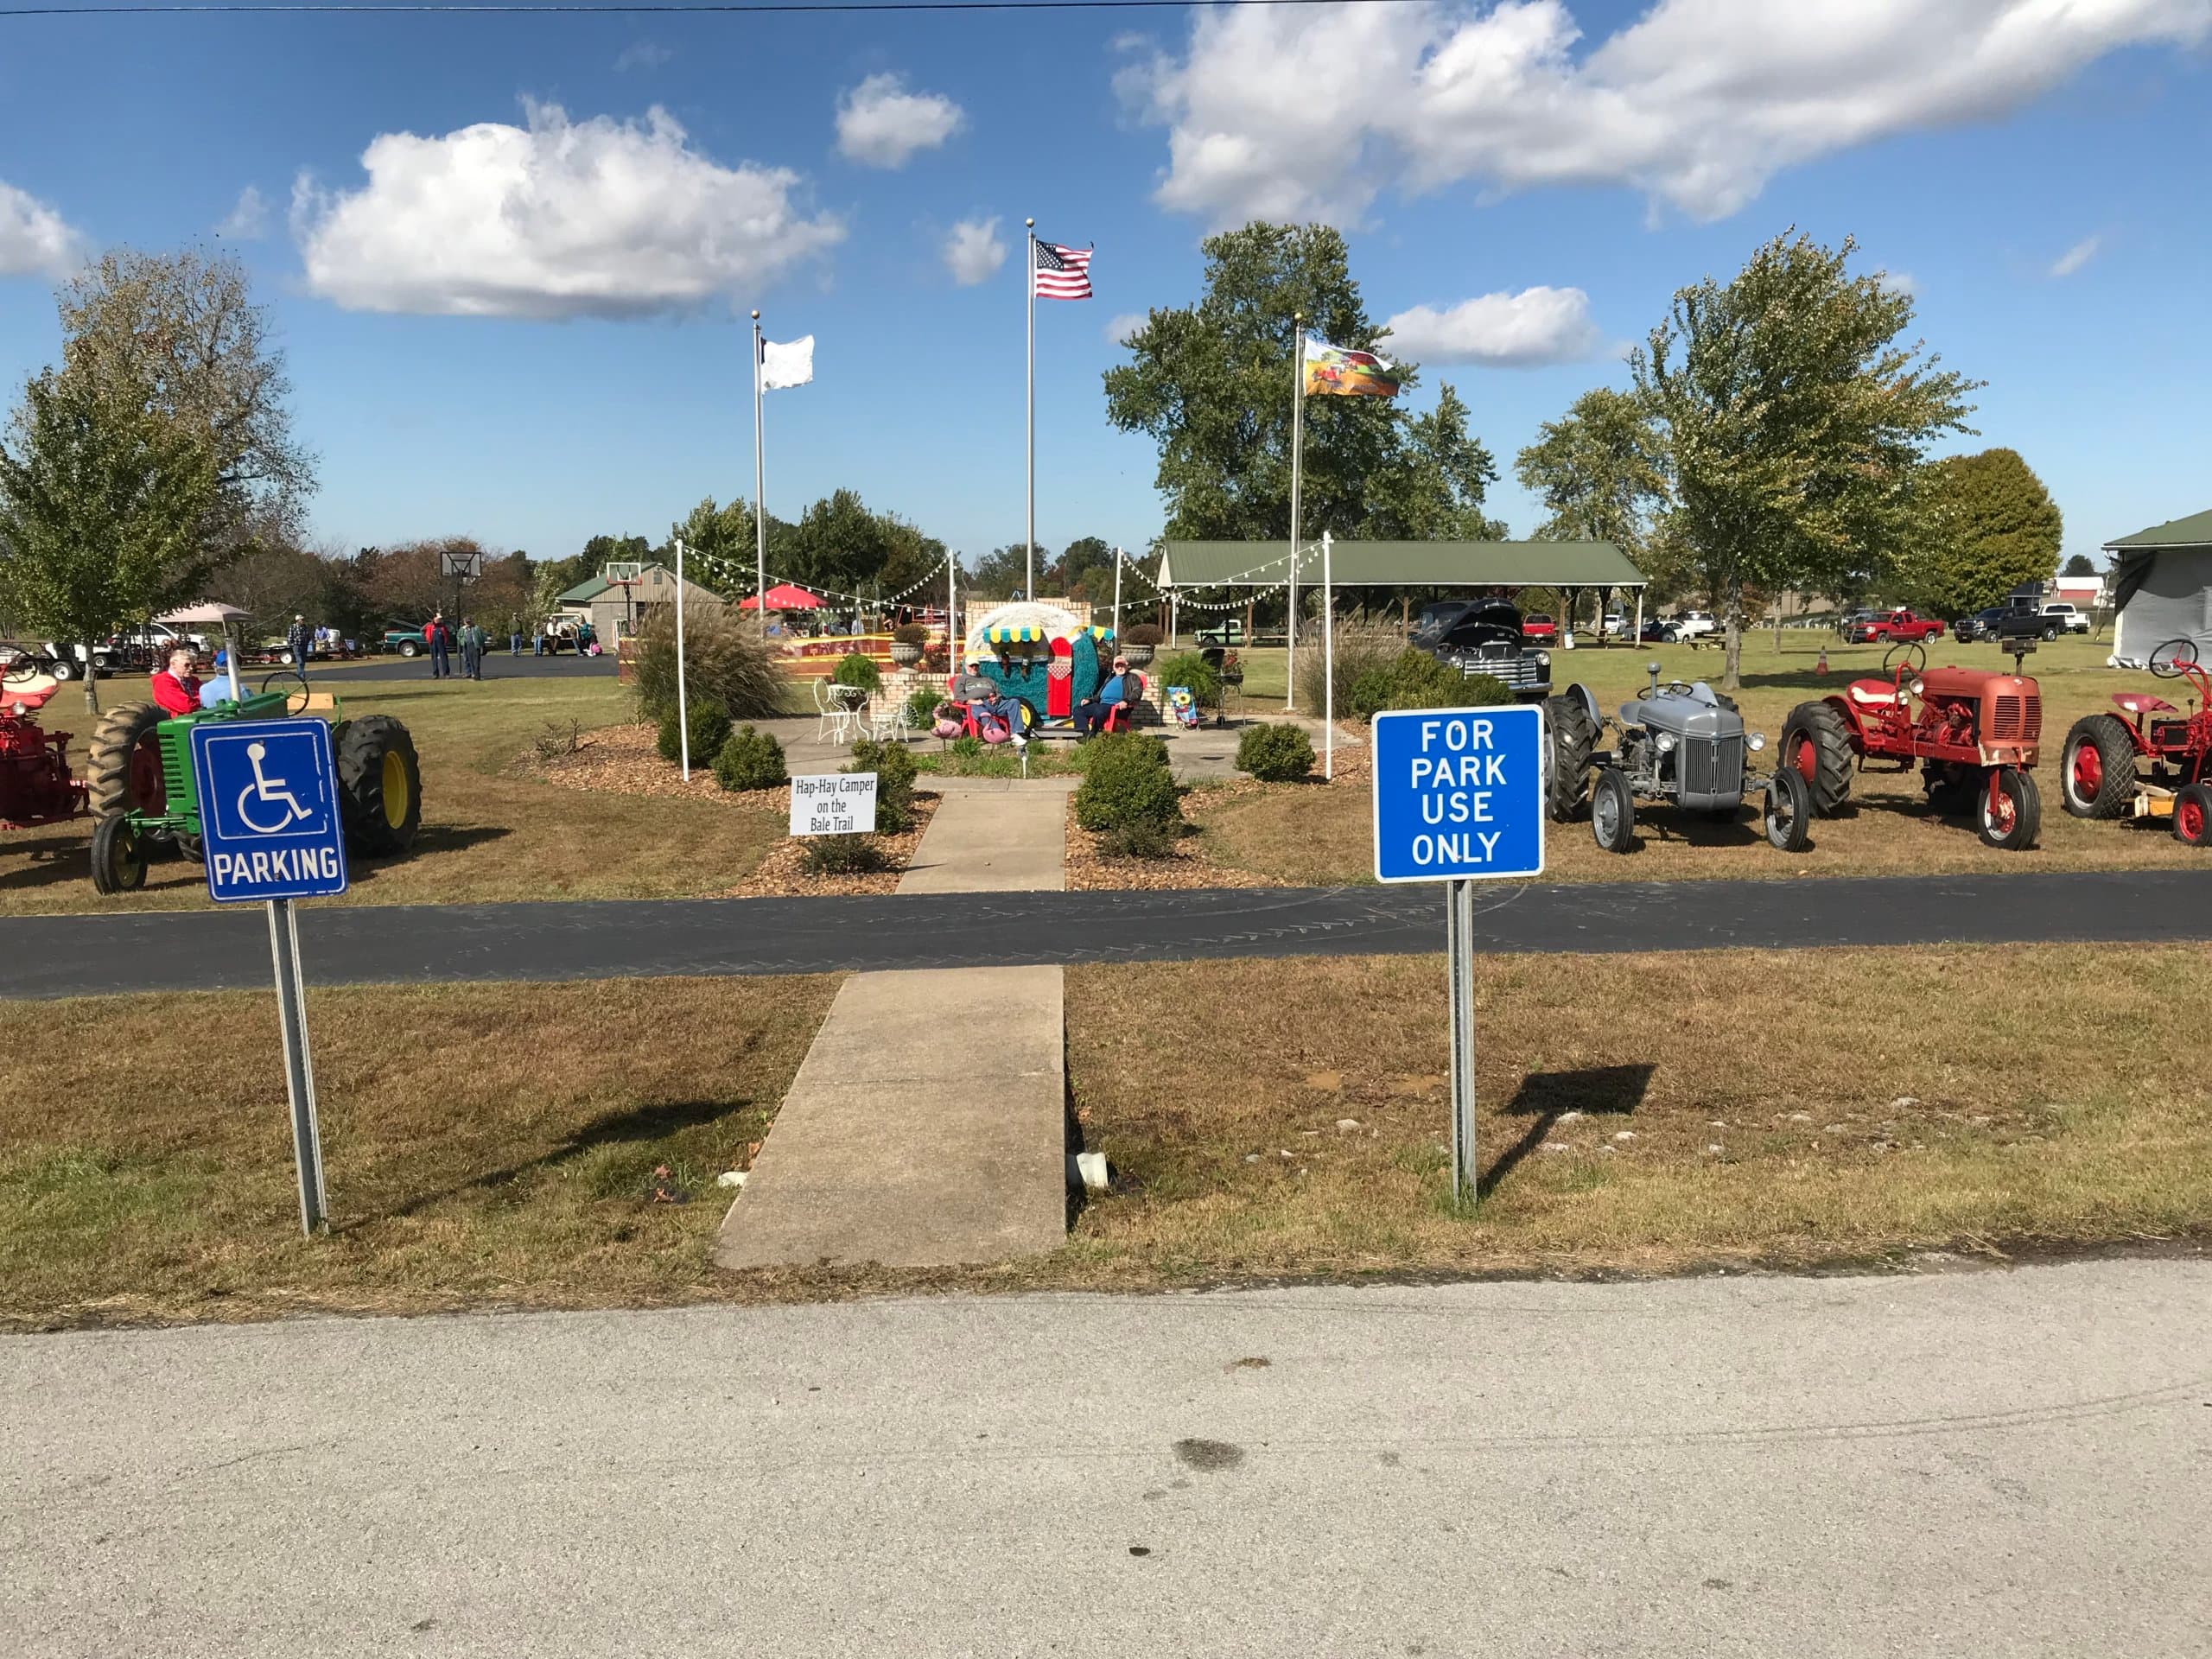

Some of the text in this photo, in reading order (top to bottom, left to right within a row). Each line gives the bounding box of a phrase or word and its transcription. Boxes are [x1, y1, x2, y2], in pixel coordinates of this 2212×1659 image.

[1421, 719, 1494, 753] FOR
[1411, 753, 1507, 789] PARK
[796, 778, 875, 798] Hap-Hay Camper
[817, 798, 847, 814] on the
[1421, 791, 1494, 824] USE
[810, 815, 854, 832] Bale Trail
[1412, 830, 1502, 866] ONLY
[213, 847, 339, 886] PARKING
